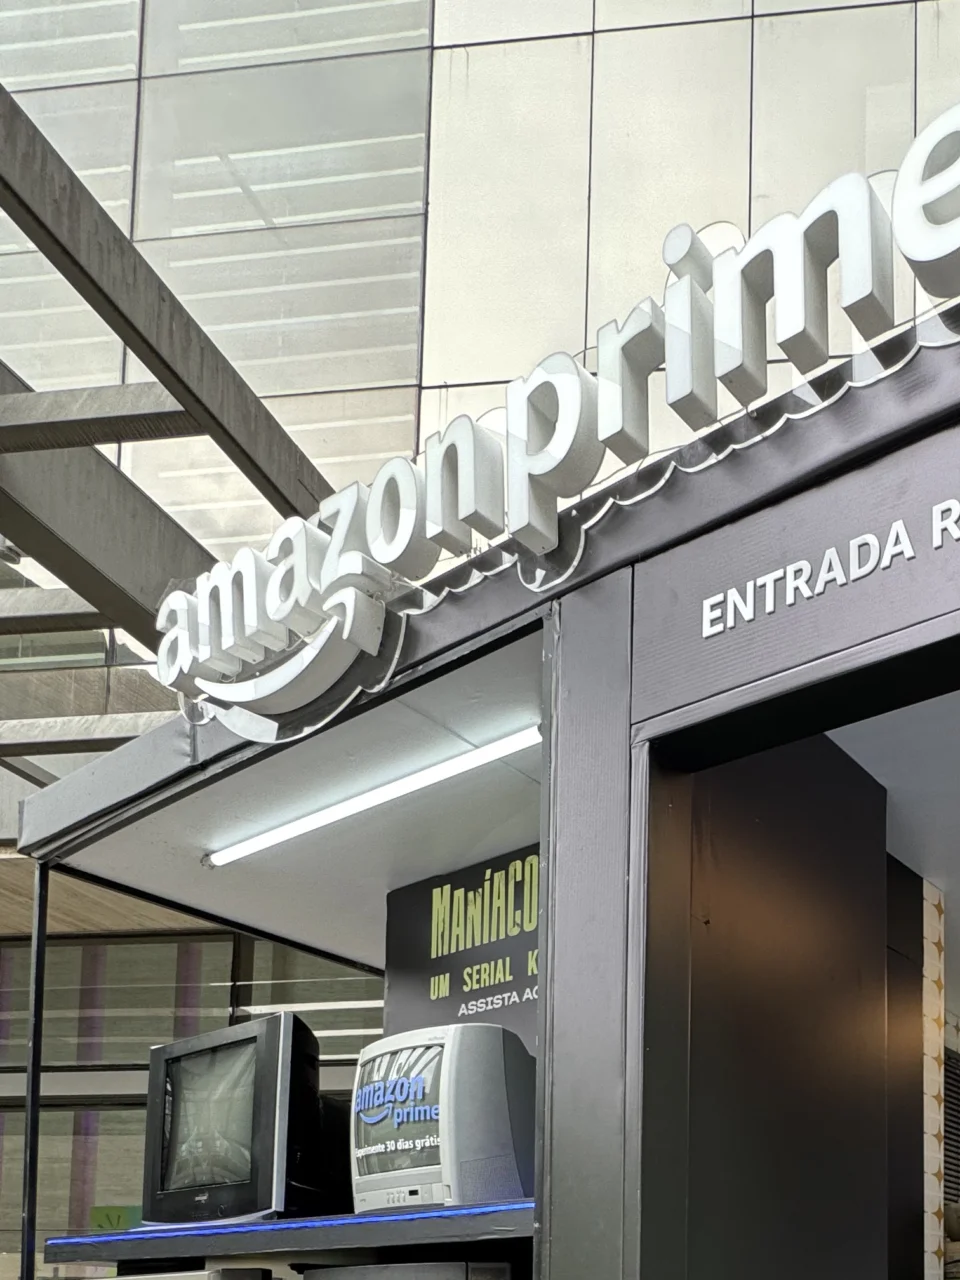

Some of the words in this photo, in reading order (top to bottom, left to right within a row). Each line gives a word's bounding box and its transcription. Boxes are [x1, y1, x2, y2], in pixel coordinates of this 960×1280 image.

[156, 414, 502, 690] amazon
[702, 518, 916, 639] ENTRADA
[431, 855, 538, 959] MANÍACO
[430, 973, 450, 1000] UM
[462, 956, 514, 992] SERIAL
[458, 991, 520, 1017] ASSISTA
[355, 1074, 425, 1113] amazon
[393, 1102, 440, 1129] prime
[386, 1140, 396, 1152] 30
[396, 1138, 414, 1150] dias
